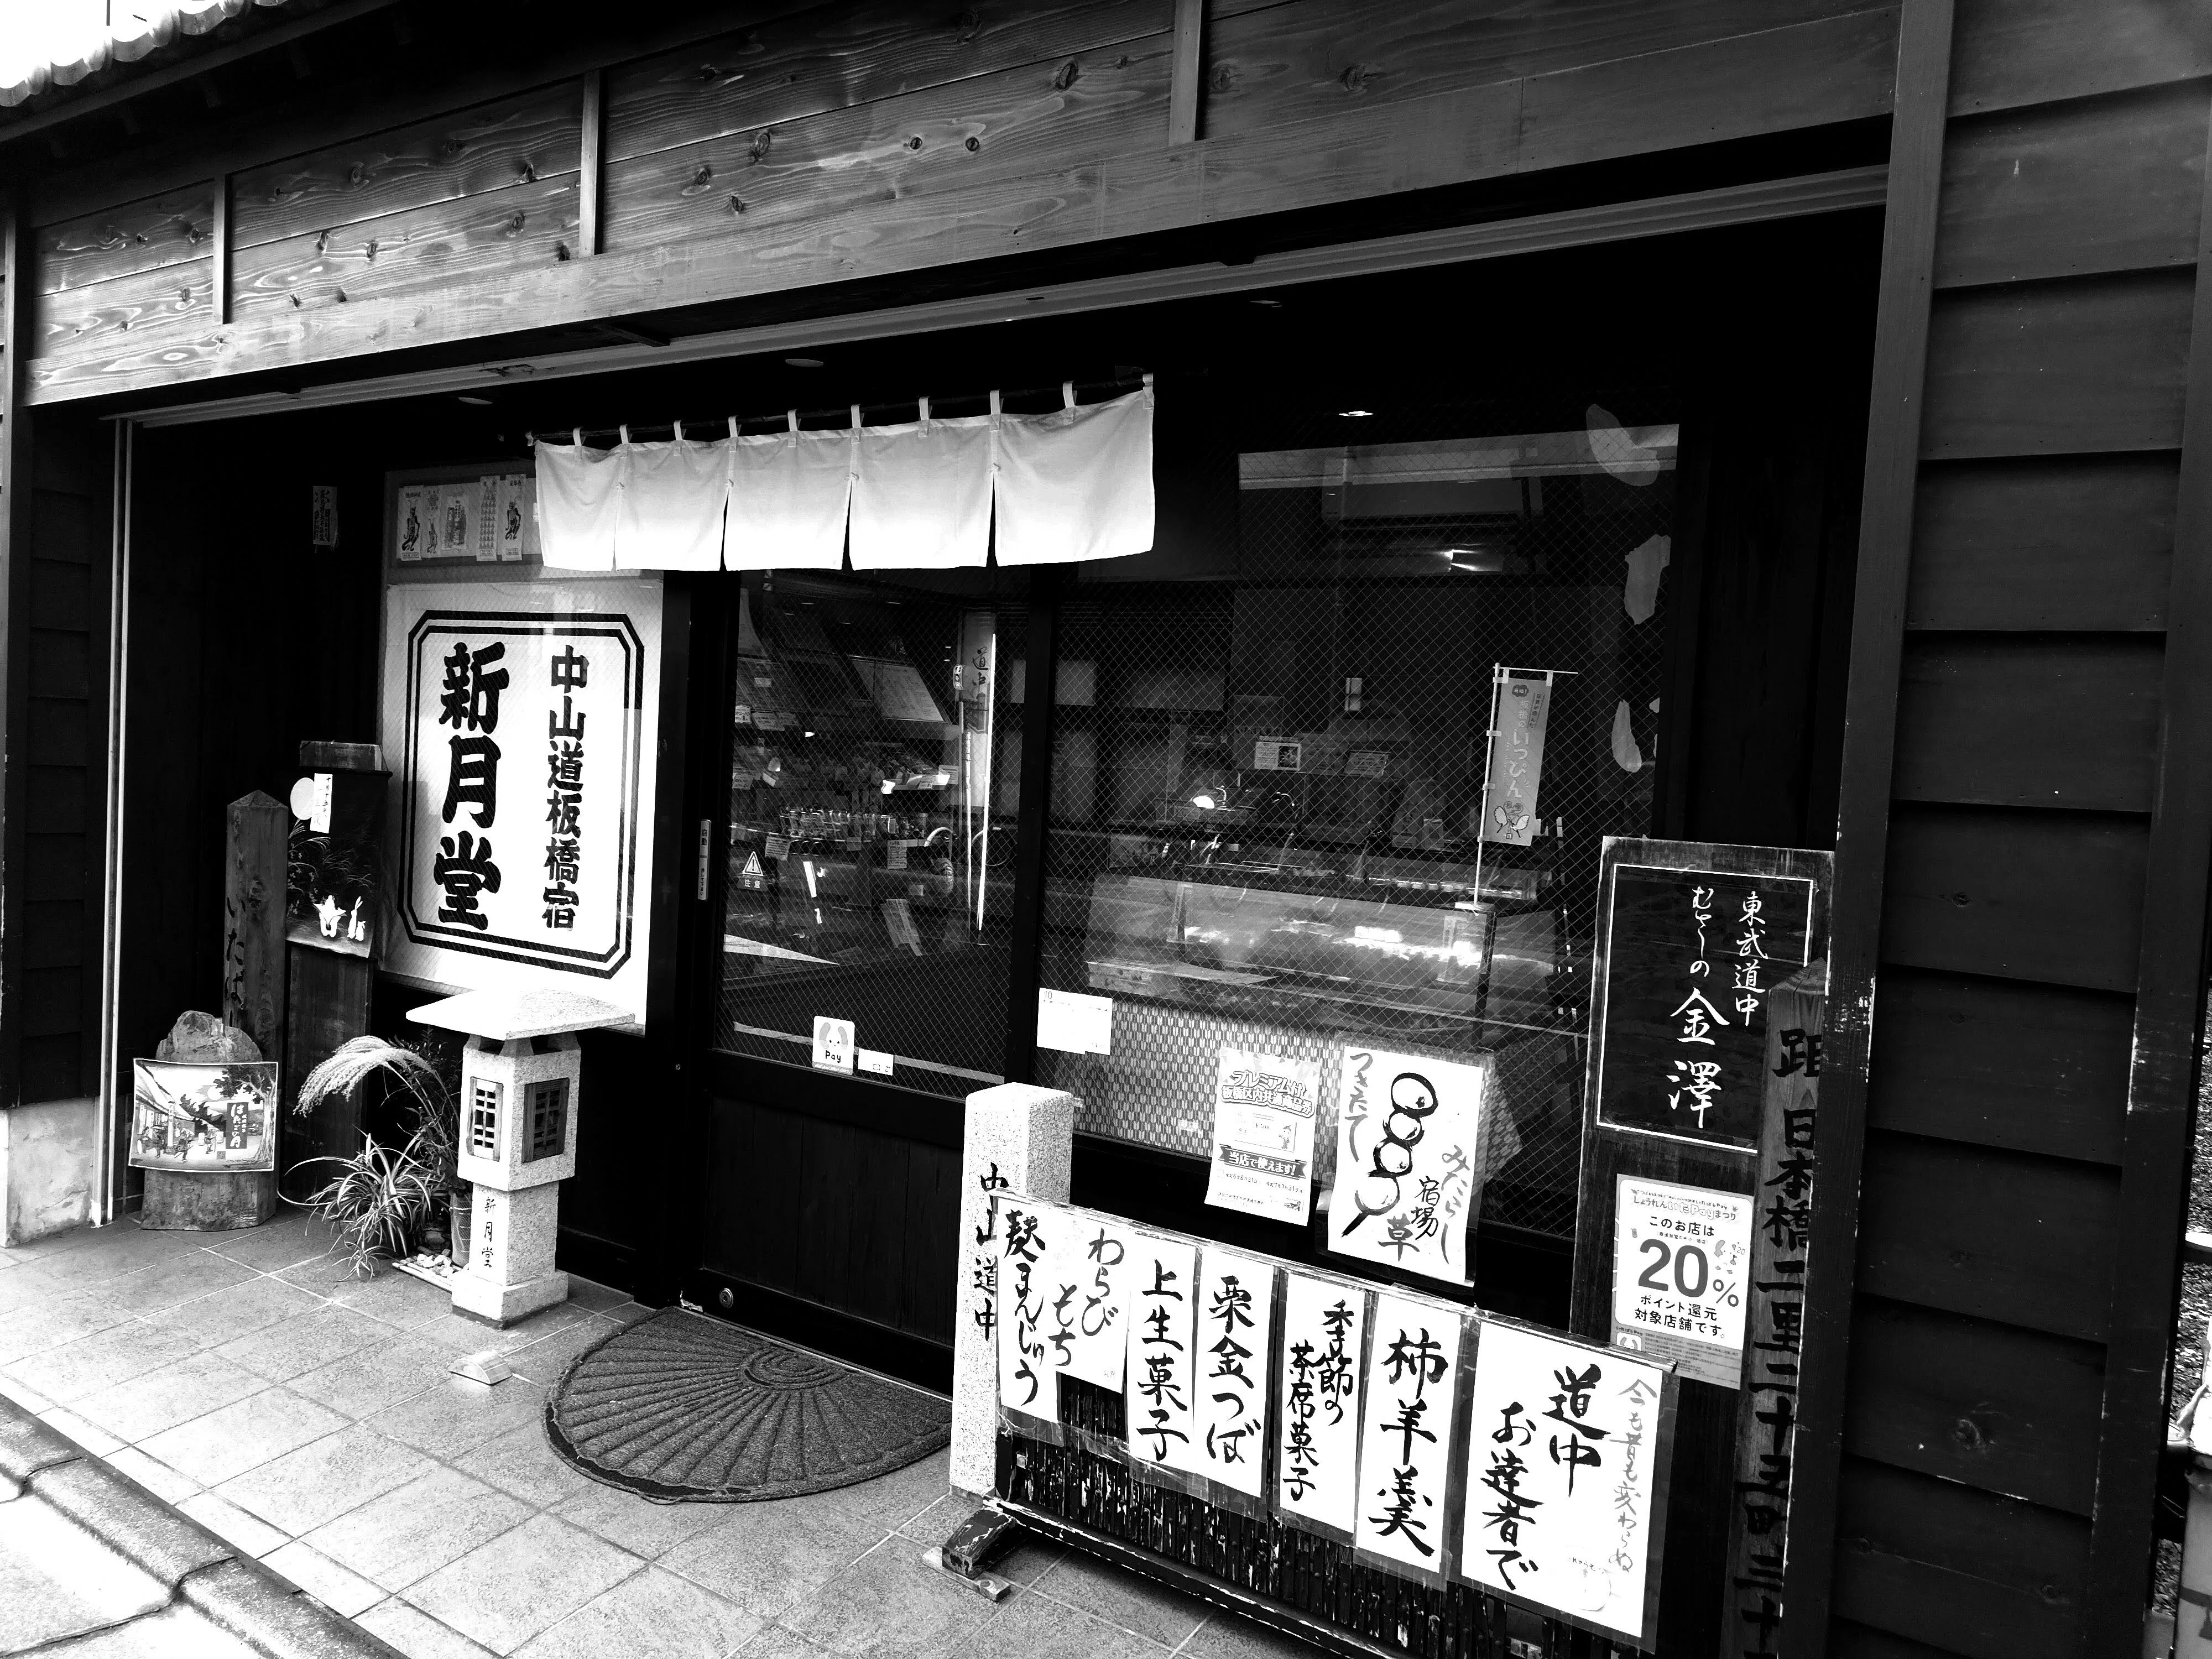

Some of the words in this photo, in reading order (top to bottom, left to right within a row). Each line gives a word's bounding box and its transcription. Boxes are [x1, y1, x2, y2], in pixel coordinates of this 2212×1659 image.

[433, 641, 510, 931] 新月堂
[541, 644, 589, 930] 中山道板橋宿
[744, 879, 761, 889] 注意
[1732, 891, 1768, 1027] 東武道中
[825, 1050, 841, 1063] Pay
[1344, 1052, 1374, 1162] つきたて
[1228, 1151, 1297, 1176] 当店で使えます!
[1410, 1176, 1441, 1240] 宿場
[1441, 1144, 1470, 1264] みたらし
[482, 1196, 497, 1268] 新月堂
[1082, 1227, 1125, 1337] わらび
[1377, 1212, 1420, 1261] 草
[1650, 1216, 1714, 1237] このお店は
[1047, 1283, 1077, 1366] もち
[1136, 1259, 1190, 1462] 上生菓子
[1318, 1299, 1354, 1426] 季節の
[1634, 1307, 1725, 1339] 対象店舗です。
[1641, 1295, 1717, 1321] ポイント還元
[1207, 1275, 1261, 1464] 栗金つば
[1282, 1339, 1319, 1501] 茶席菓子
[1368, 1328, 1449, 1557] 柿羊羹
[1541, 1364, 1611, 1498] 道中
[1609, 1379, 1657, 1573] 今も昔も変わらぬ
[1480, 1401, 1545, 1590] お達者で
